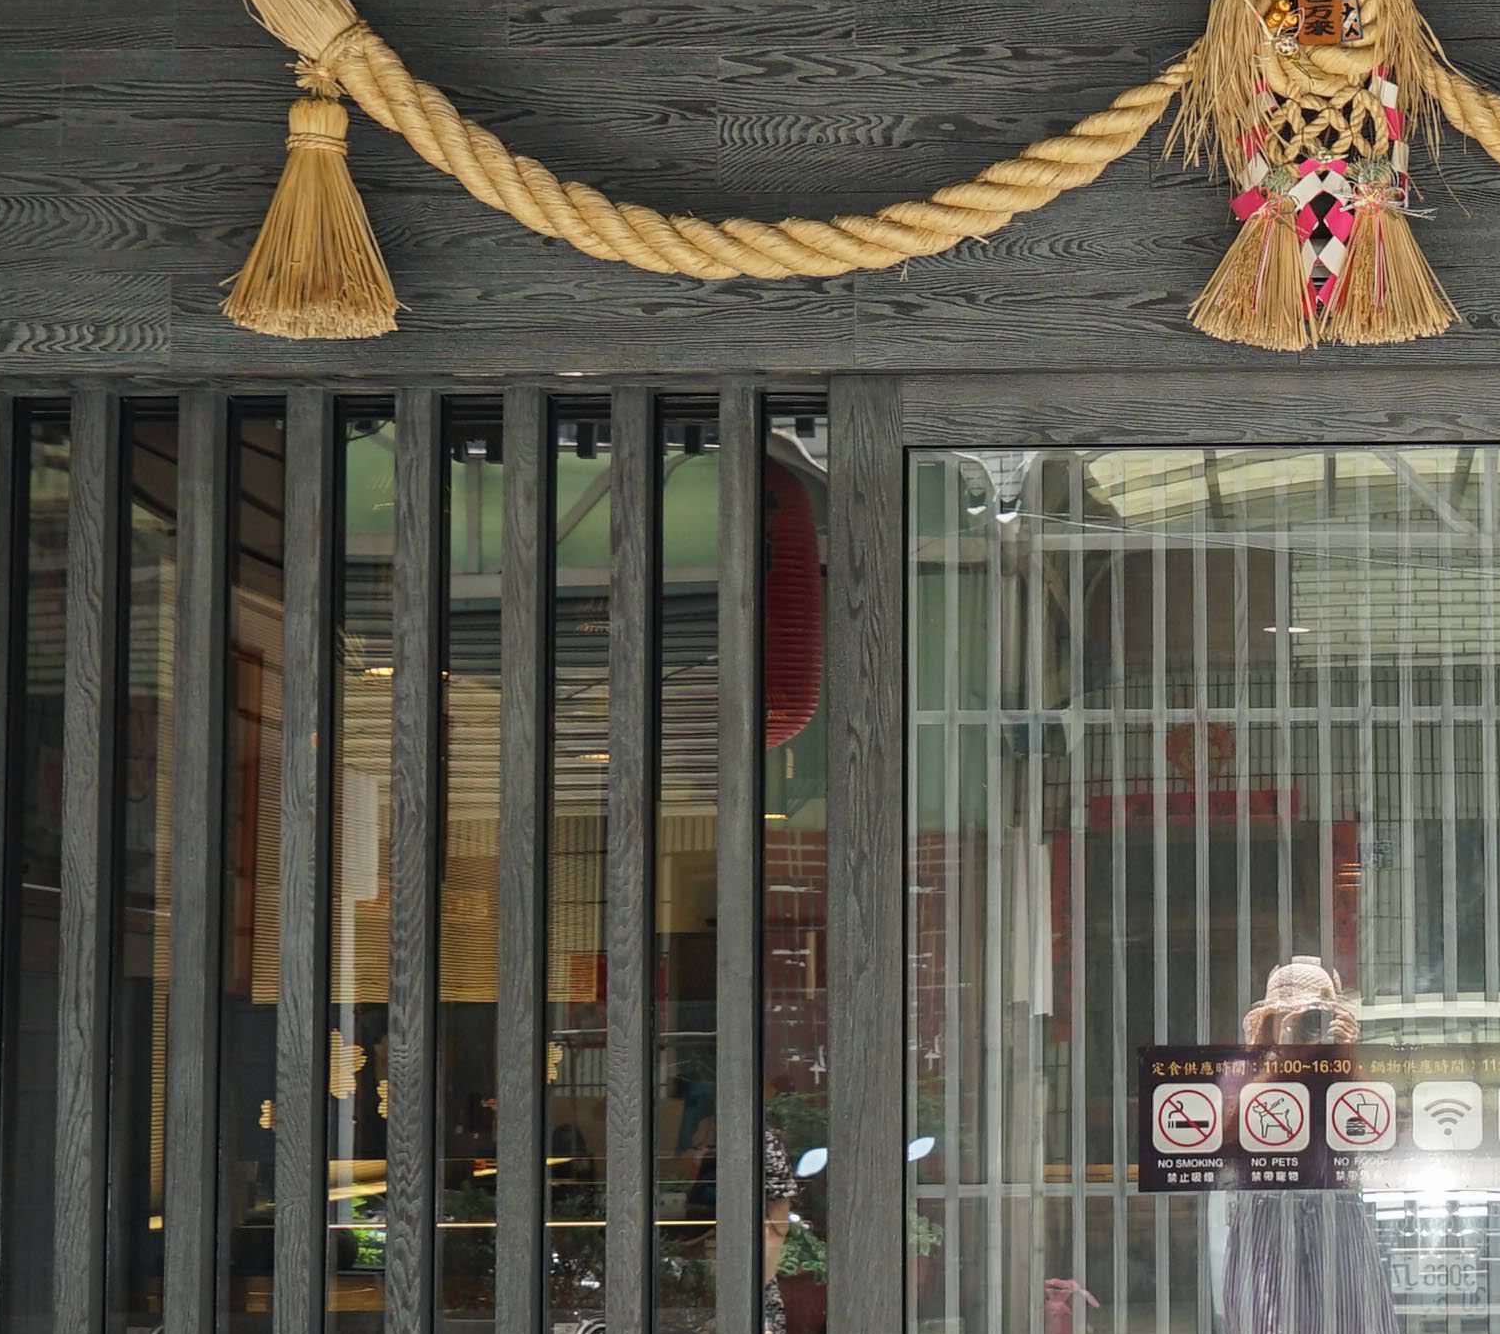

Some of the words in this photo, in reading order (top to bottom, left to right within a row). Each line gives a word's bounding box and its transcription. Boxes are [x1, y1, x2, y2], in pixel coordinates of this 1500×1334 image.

[1158, 1158, 1173, 1169] NO
[1175, 1158, 1224, 1169] SMOKING
[1251, 1157, 1267, 1167] NO
[1272, 1157, 1299, 1167] PETS
[1334, 1157, 1349, 1167] NO
